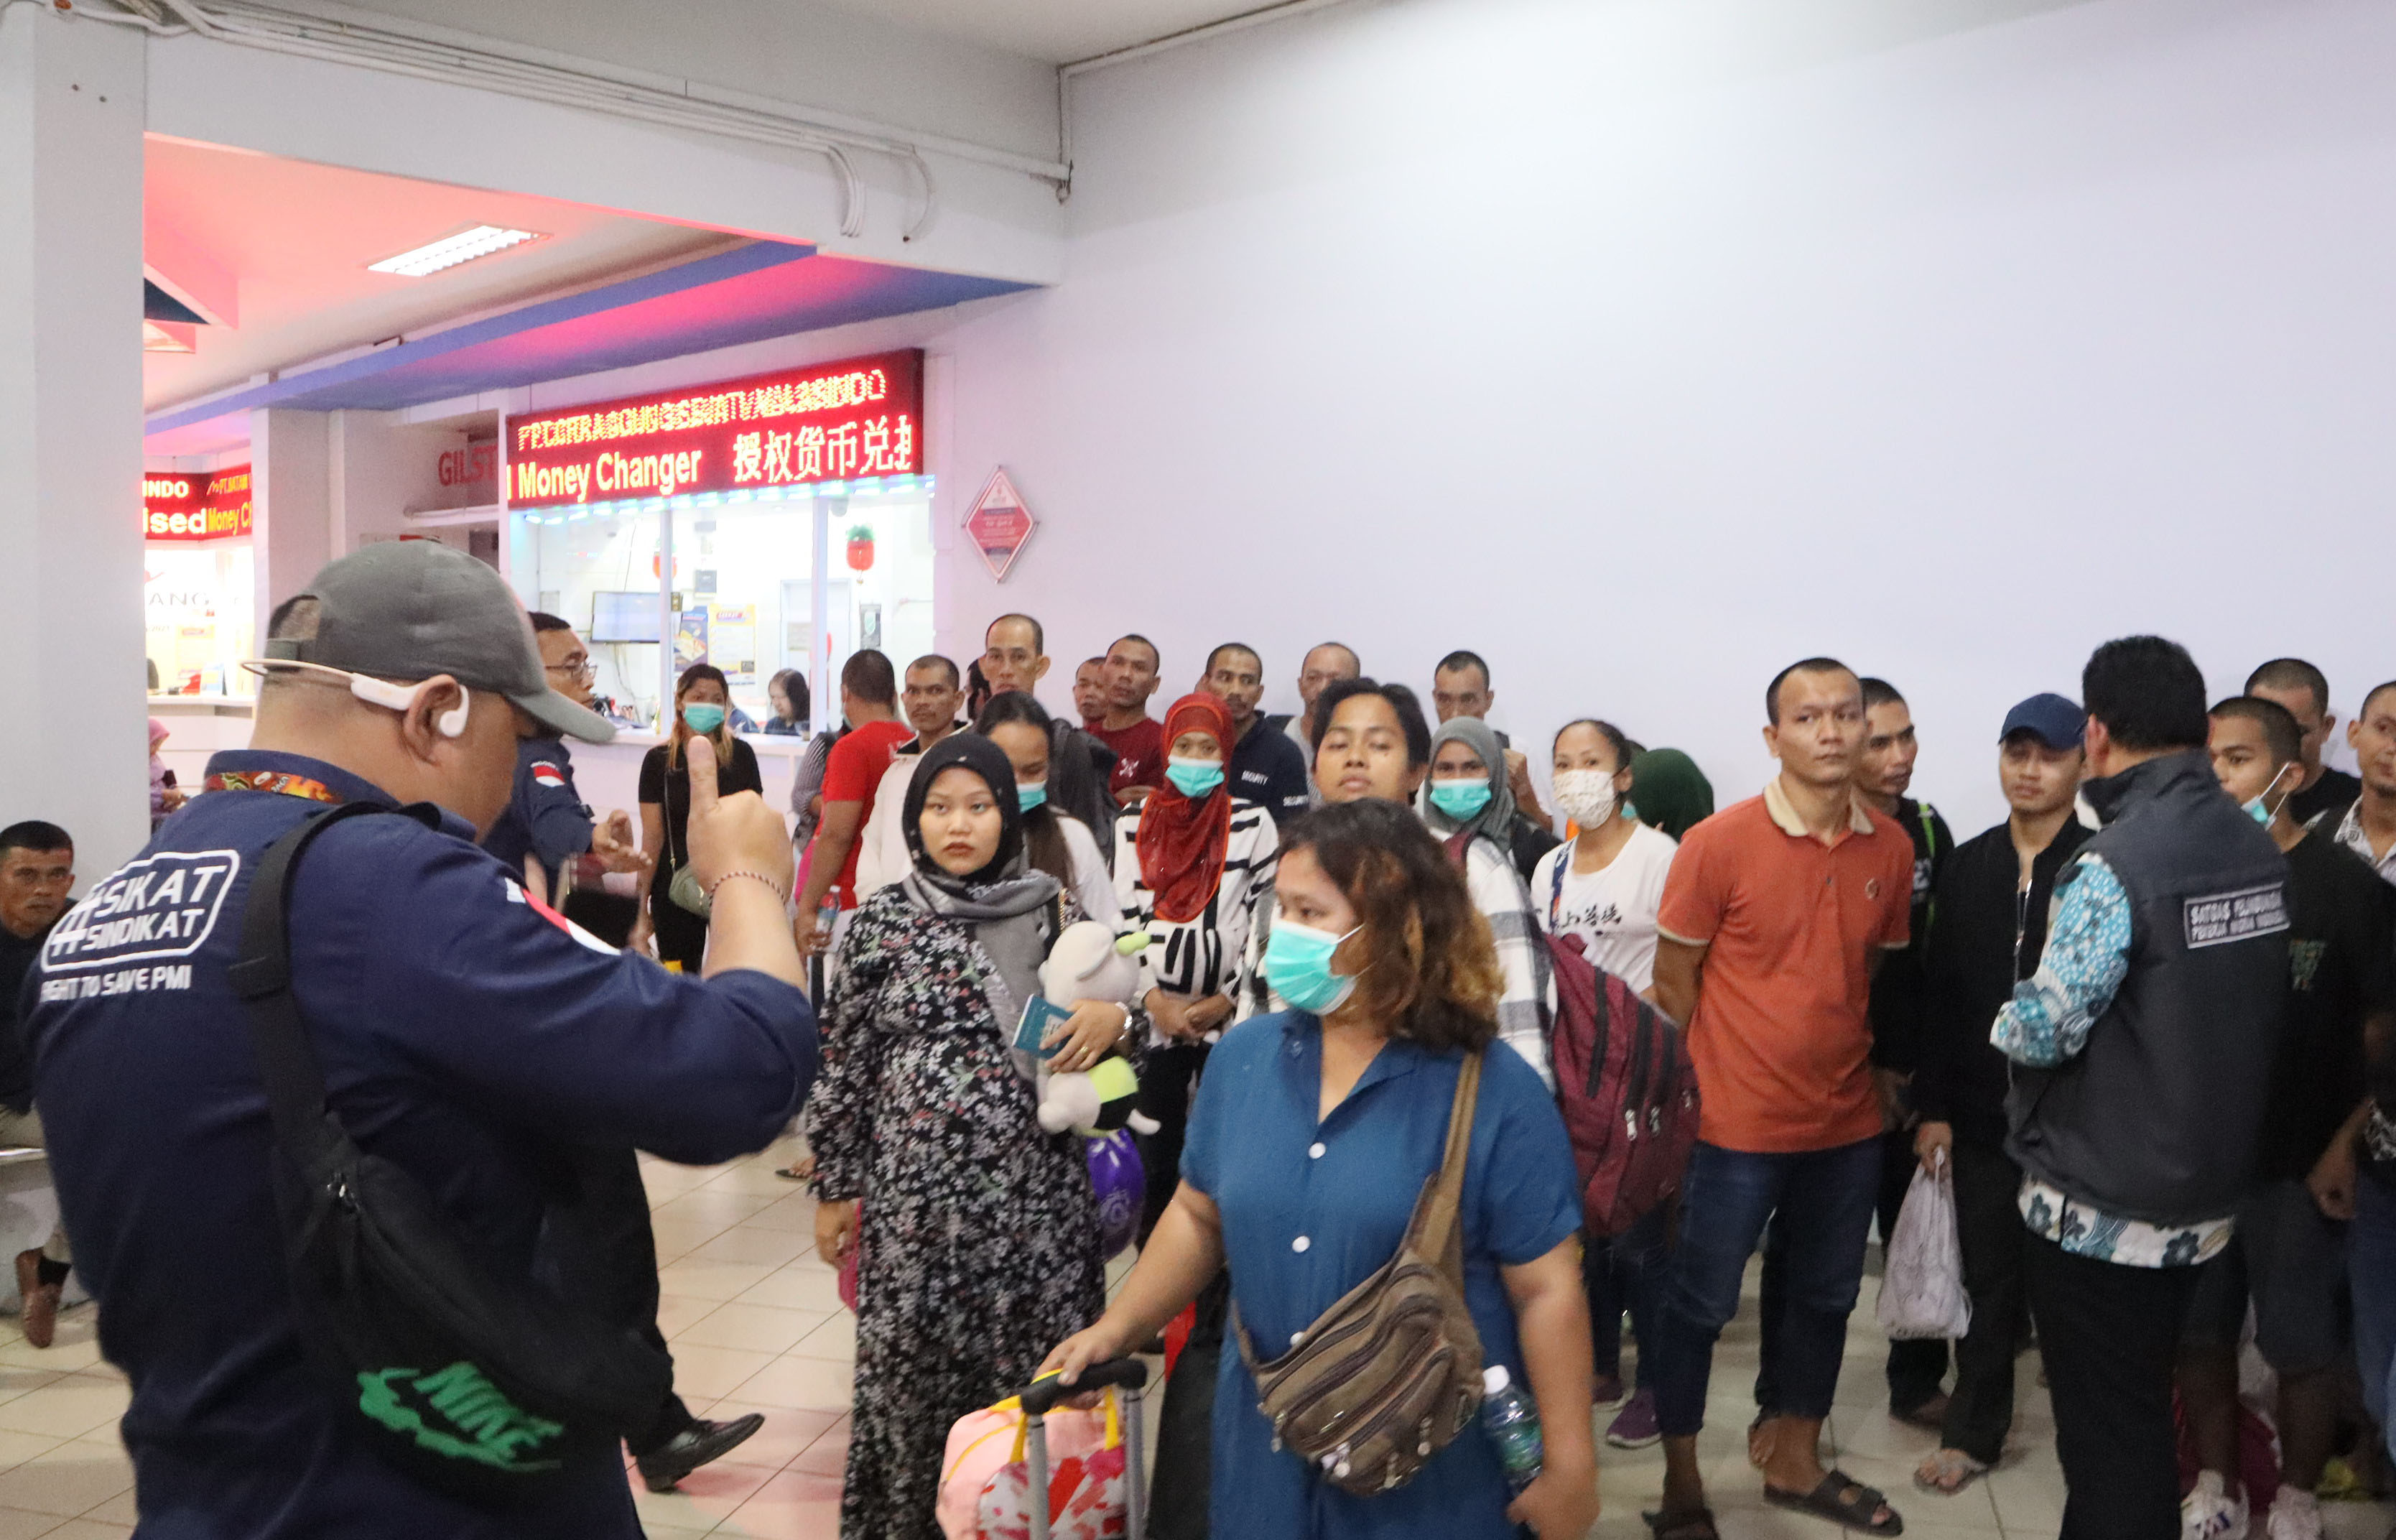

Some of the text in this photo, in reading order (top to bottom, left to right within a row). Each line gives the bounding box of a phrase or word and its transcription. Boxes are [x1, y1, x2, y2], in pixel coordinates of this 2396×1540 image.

[518, 462, 591, 503] Money
[596, 450, 702, 495] Changer
[208, 506, 240, 536] Money
[101, 968, 150, 996] SAVE
[151, 965, 192, 990] PMI
